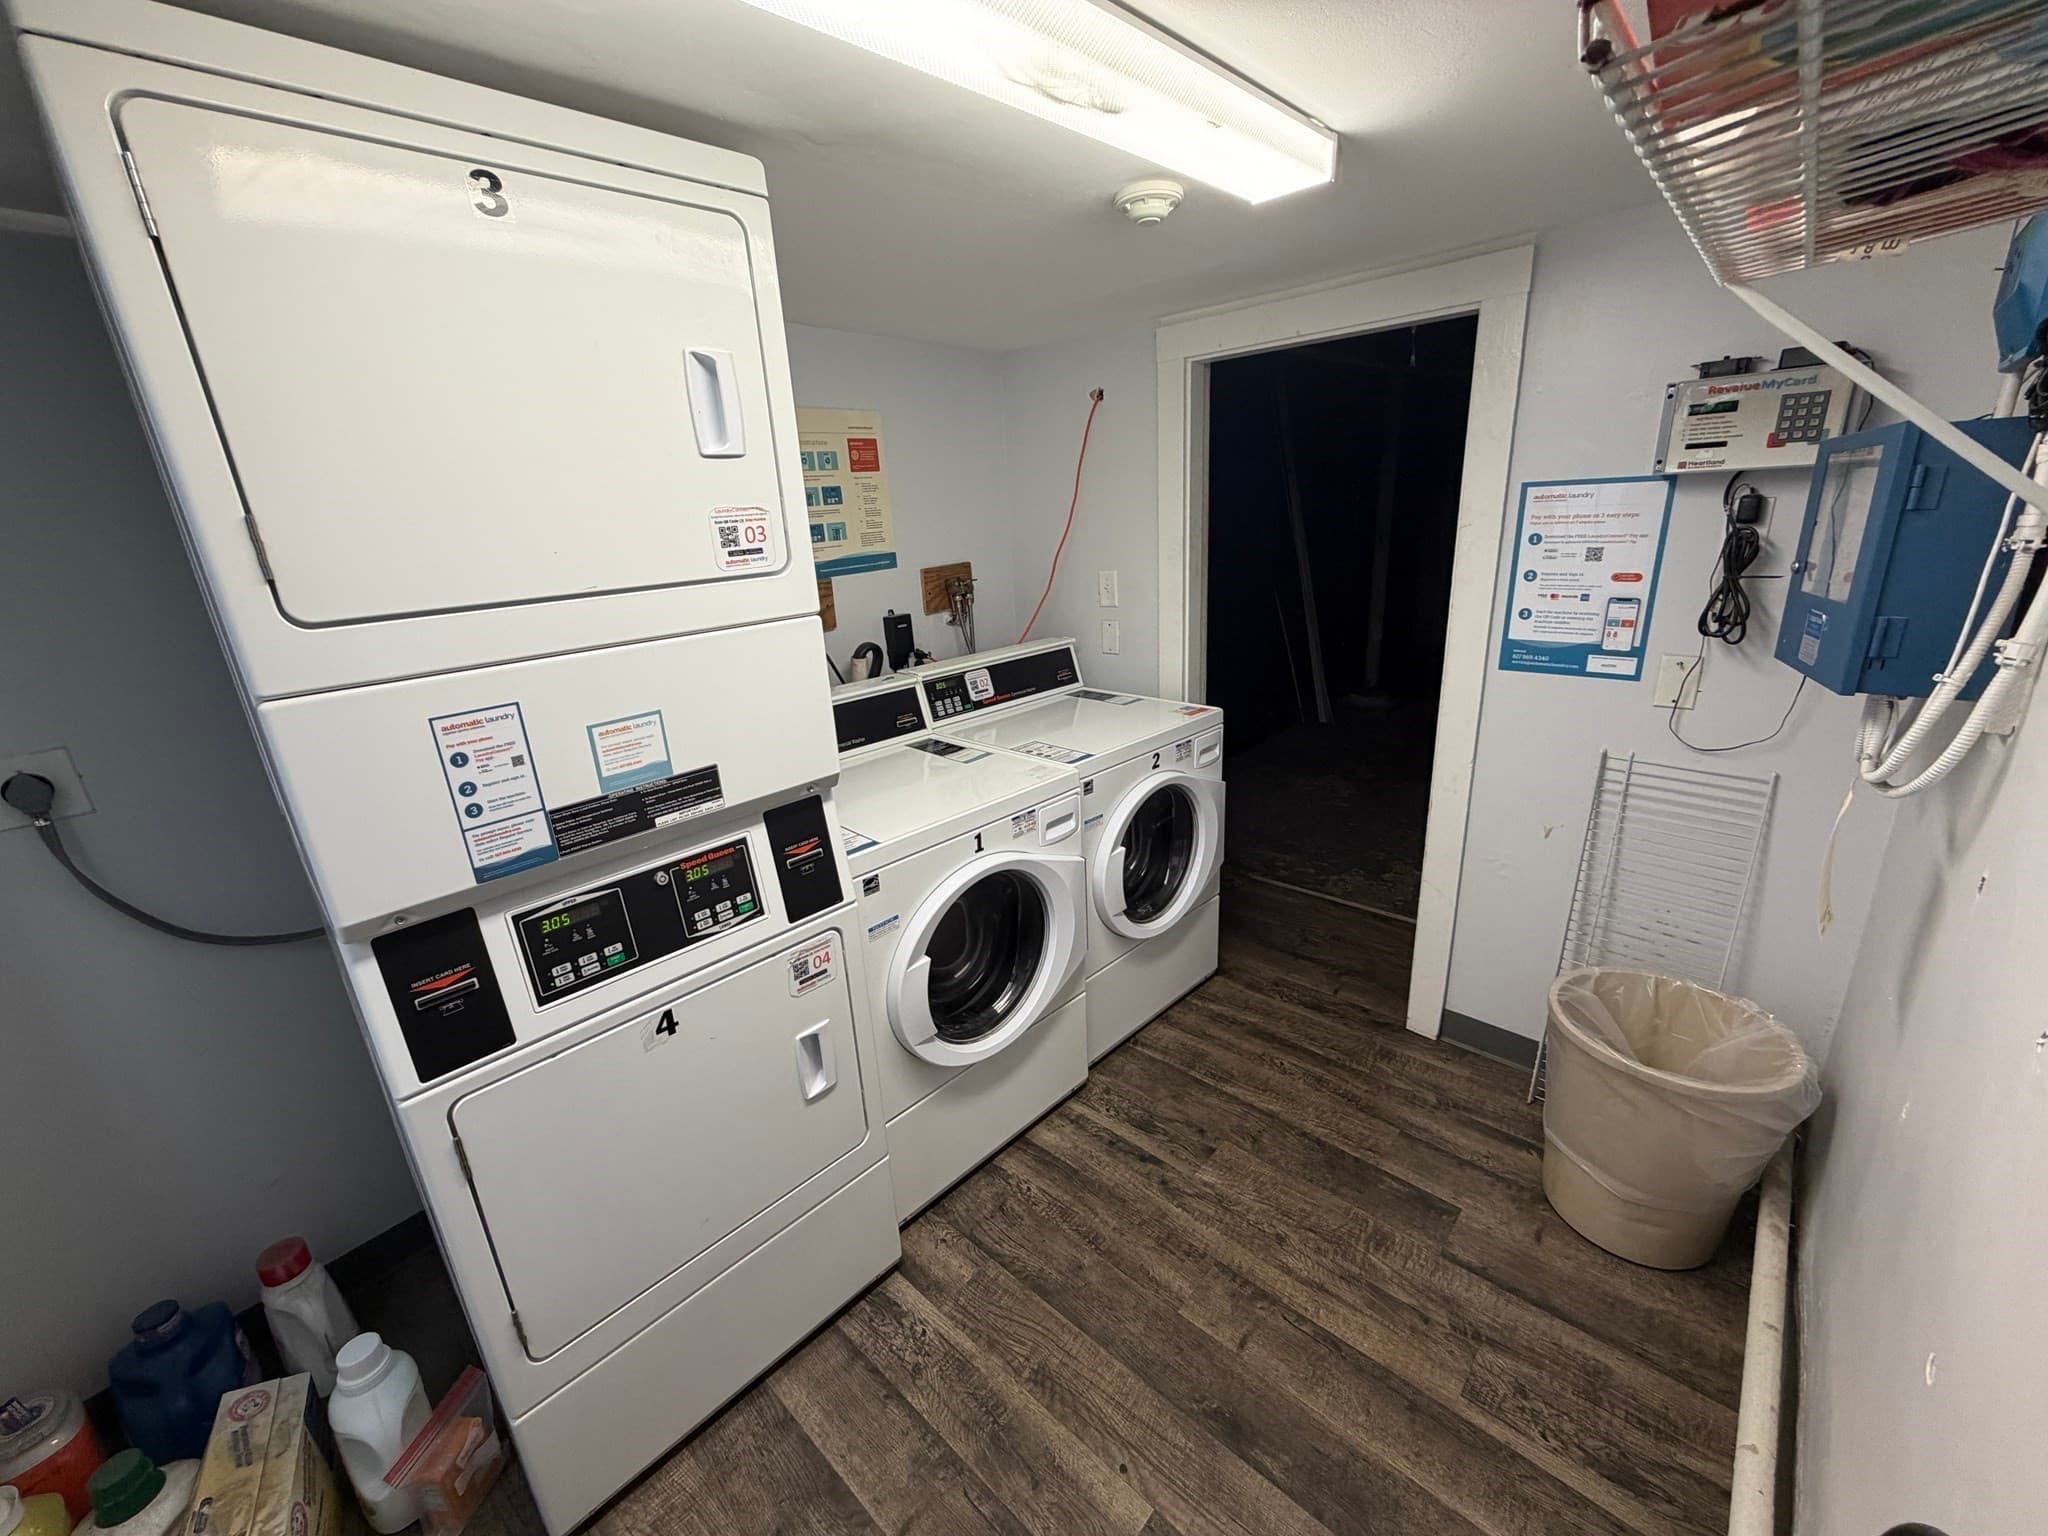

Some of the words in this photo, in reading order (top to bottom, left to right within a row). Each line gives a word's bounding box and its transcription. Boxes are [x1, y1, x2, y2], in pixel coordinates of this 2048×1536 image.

[469, 169, 508, 217] 3
[745, 525, 767, 544] 03
[1531, 535, 1538, 543] 1
[1525, 572, 1534, 580] 2
[1522, 610, 1529, 618] 3
[441, 719, 485, 732] automatic
[485, 712, 515, 723] laundry
[598, 725, 633, 737] automatic
[632, 720, 656, 729] laundry
[456, 756, 463, 765] 1
[1151, 752, 1160, 770] 2
[463, 785, 473, 794] 2
[608, 788, 634, 799] OPERATING
[635, 779, 667, 791] INSTRUCTIONS
[470, 806, 478, 815] 3
[974, 831, 984, 854] 1
[680, 855, 708, 870] Speed
[708, 847, 735, 860] Queen
[813, 951, 831, 969] 04
[411, 976, 435, 988] INSERT
[435, 969, 454, 979] CARD
[454, 963, 471, 972] HERE
[656, 1008, 679, 1036] 4
